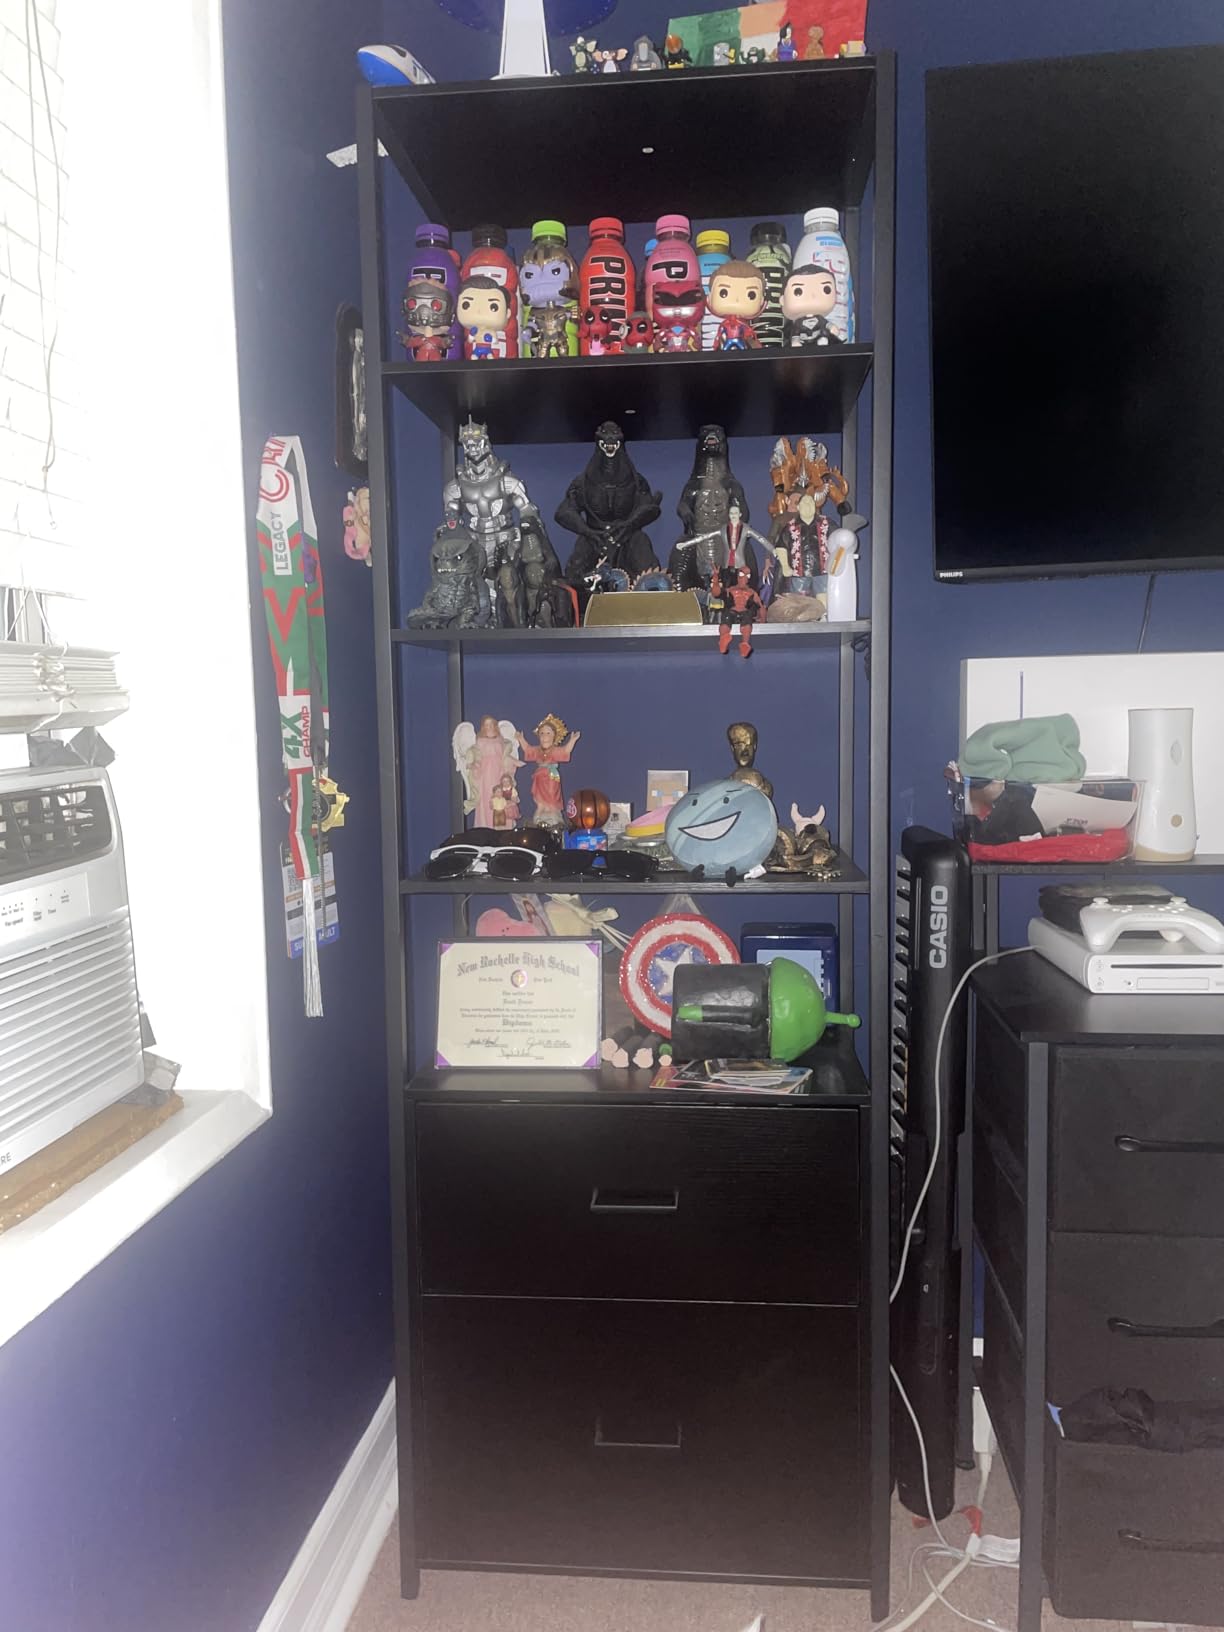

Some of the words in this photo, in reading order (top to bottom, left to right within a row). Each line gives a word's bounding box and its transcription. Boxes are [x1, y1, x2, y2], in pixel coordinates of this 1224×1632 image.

[270, 512, 289, 570] LEGACY
[302, 705, 311, 758] CHAMP
[929, 885, 948, 969] CASIO
[457, 962, 478, 977] New
[480, 953, 520, 968] Rochelle
[522, 951, 545, 969] High
[547, 955, 580, 977] School
